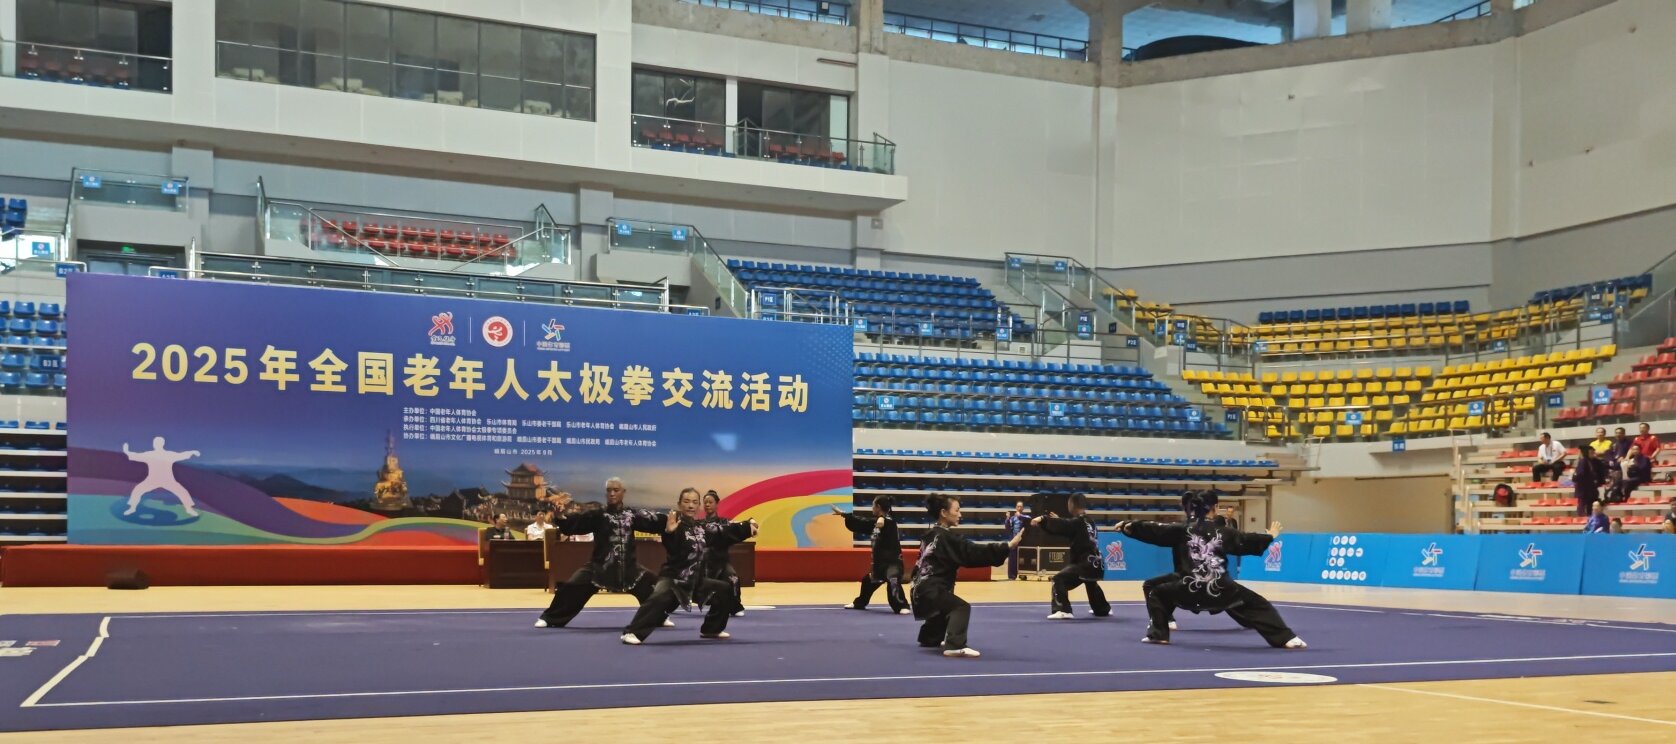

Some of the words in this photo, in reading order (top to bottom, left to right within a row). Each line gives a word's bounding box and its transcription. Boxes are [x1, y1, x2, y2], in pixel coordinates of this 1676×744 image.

[131, 342, 808, 413] 2025年全国老年人太极拳交流活动
